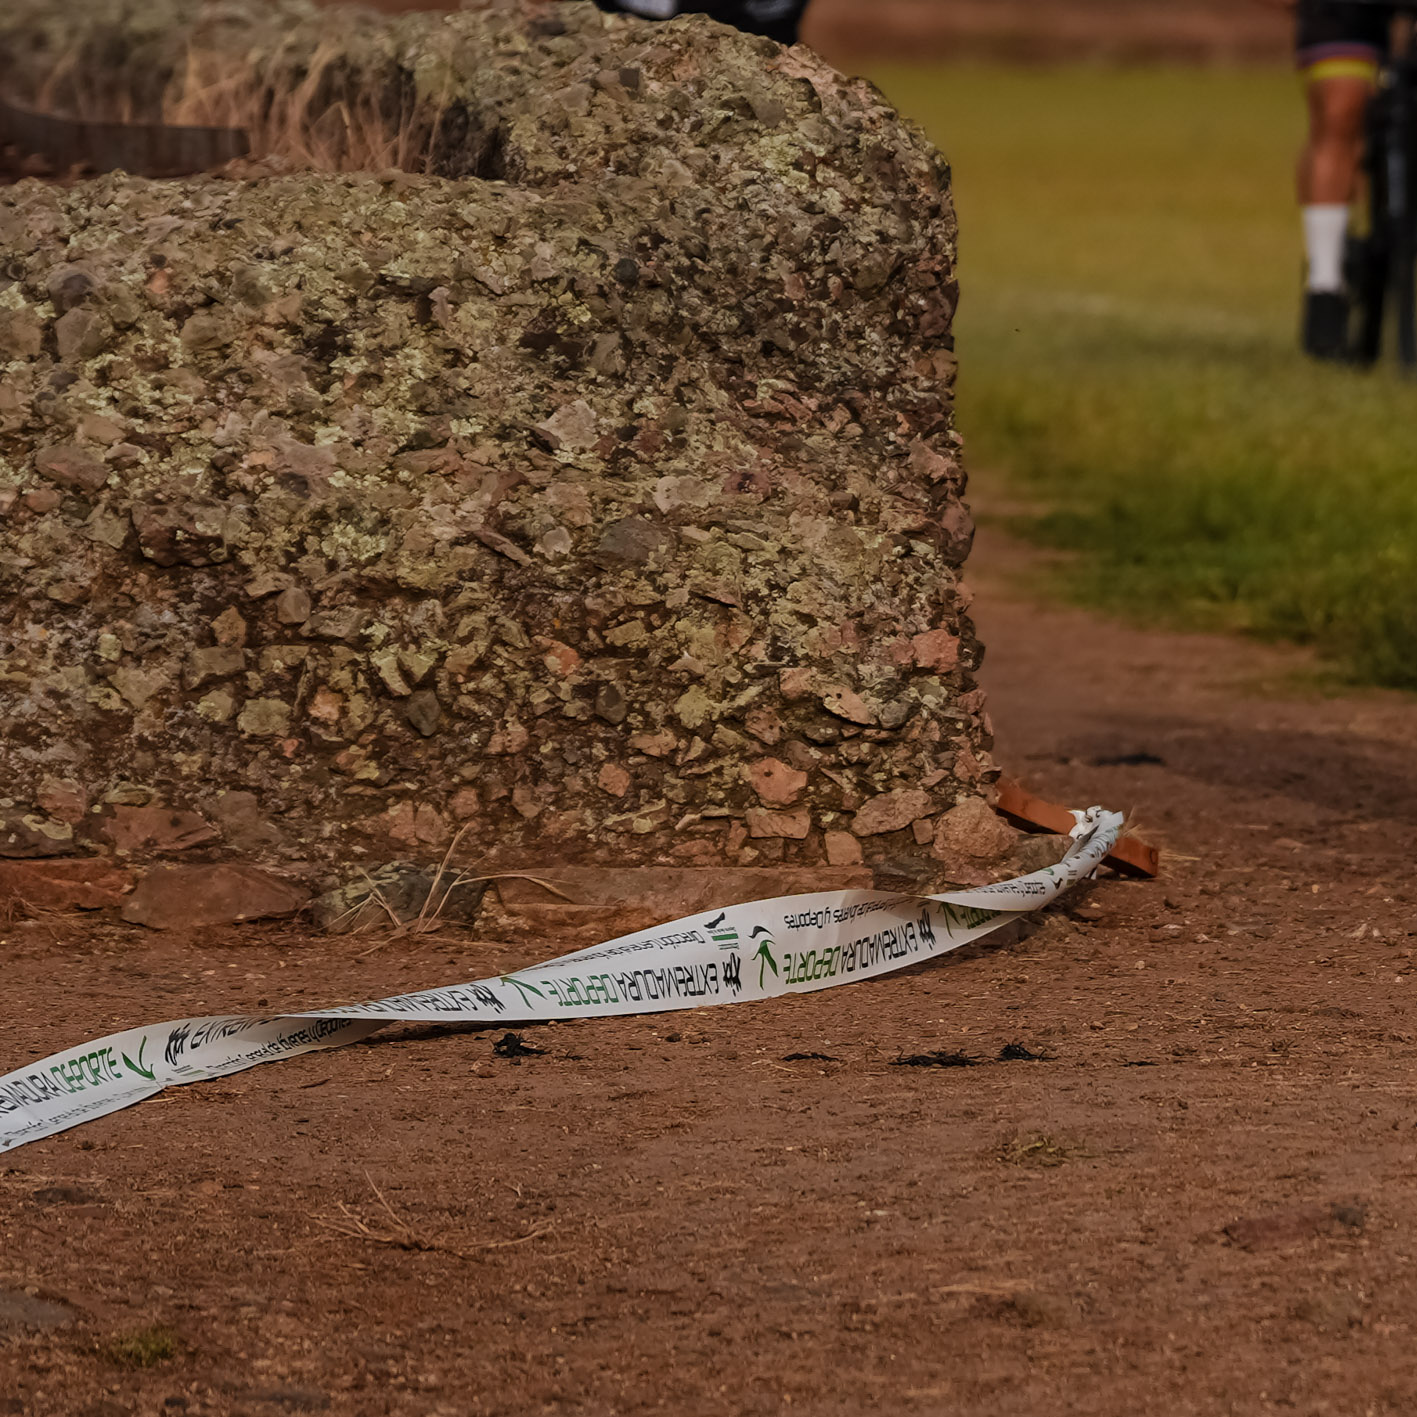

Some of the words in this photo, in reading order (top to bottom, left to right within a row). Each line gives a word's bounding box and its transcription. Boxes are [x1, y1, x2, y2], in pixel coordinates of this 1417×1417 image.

[783, 945, 841, 985] DEPORTE
[841, 922, 918, 974] EXTREMADURA
[541, 974, 619, 1007] DEPORTE
[611, 963, 719, 1002] EXTREMADURA
[50, 1046, 123, 1093] DEPORTE
